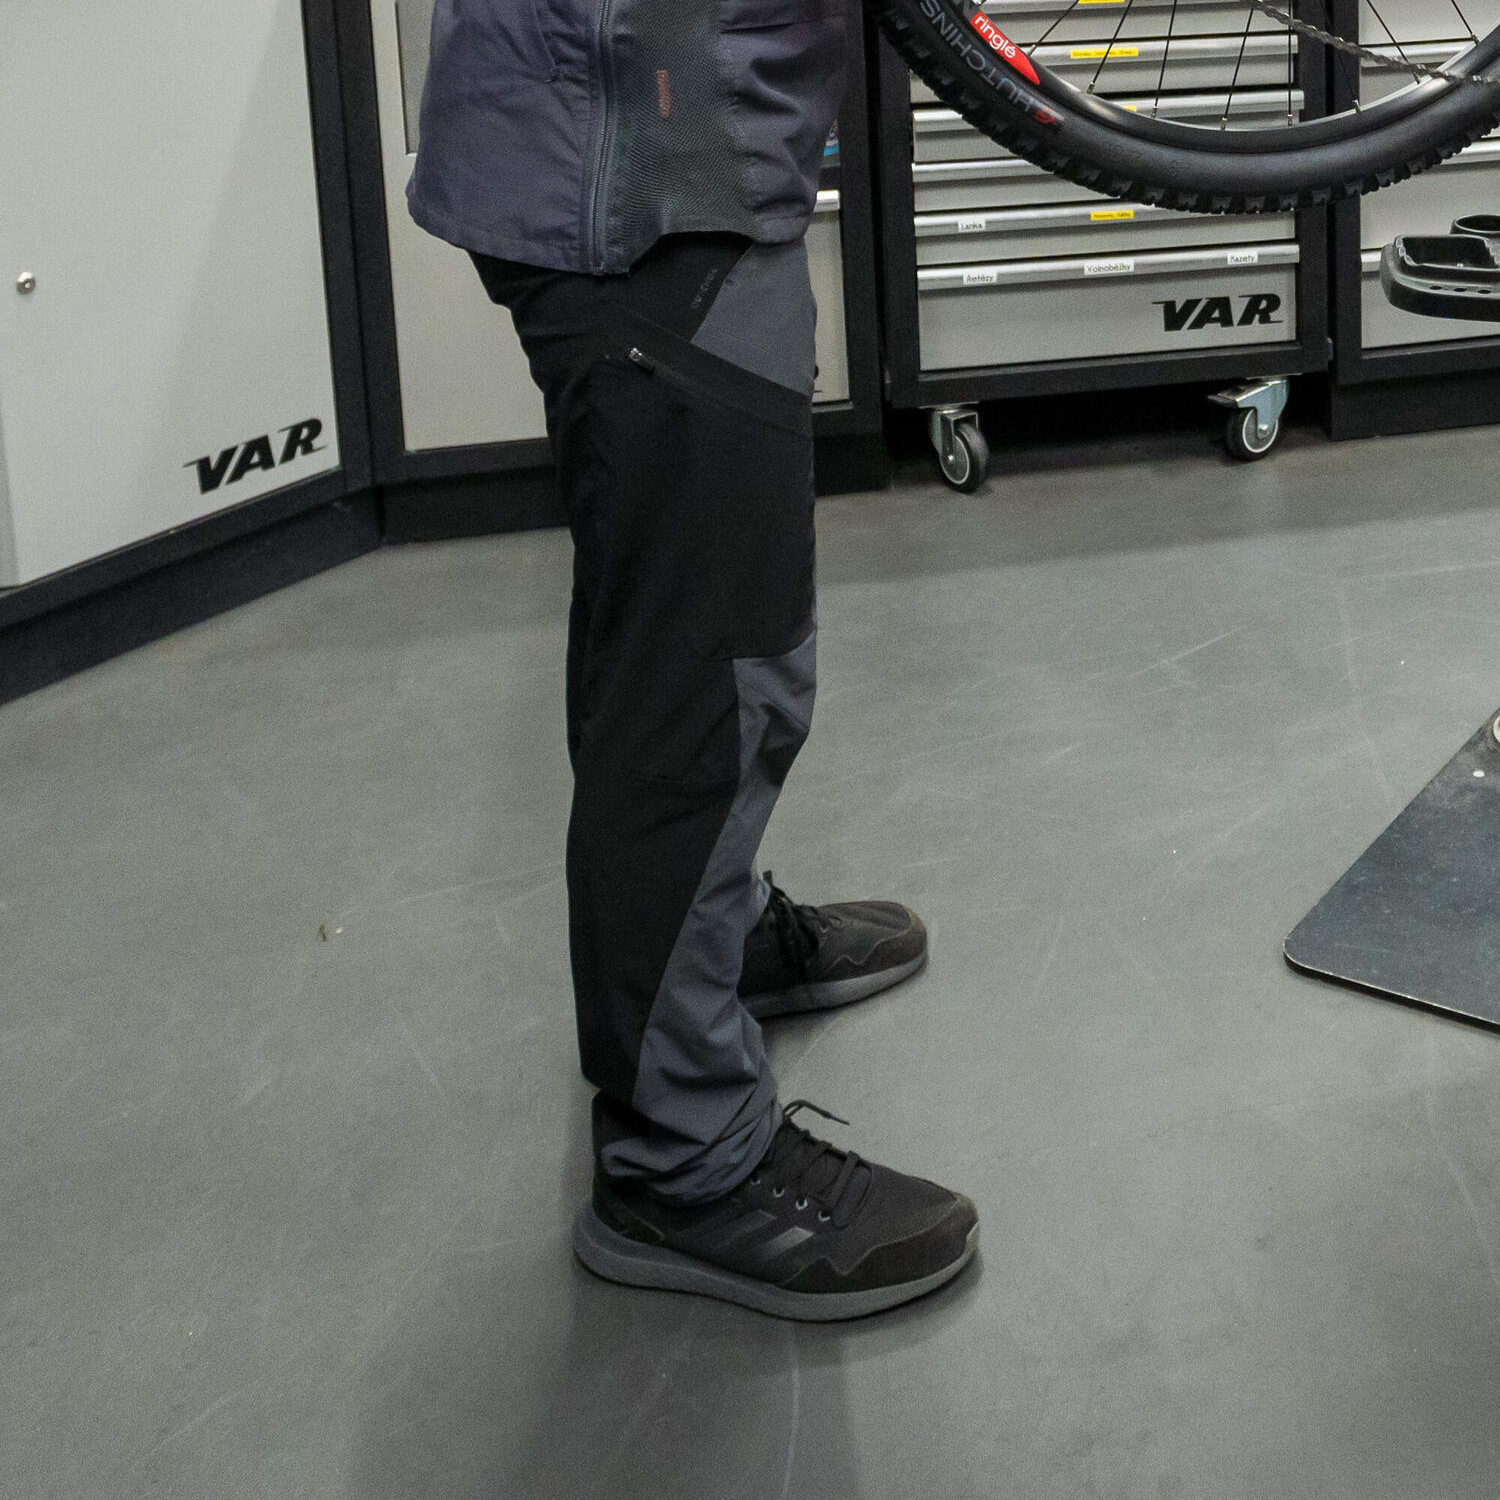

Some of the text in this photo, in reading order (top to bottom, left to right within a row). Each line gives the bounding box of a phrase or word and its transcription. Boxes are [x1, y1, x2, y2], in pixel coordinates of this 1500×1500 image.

[974, 14, 1017, 59] ringlé
[1151, 293, 1285, 332] VAR
[183, 418, 327, 494] VAR
